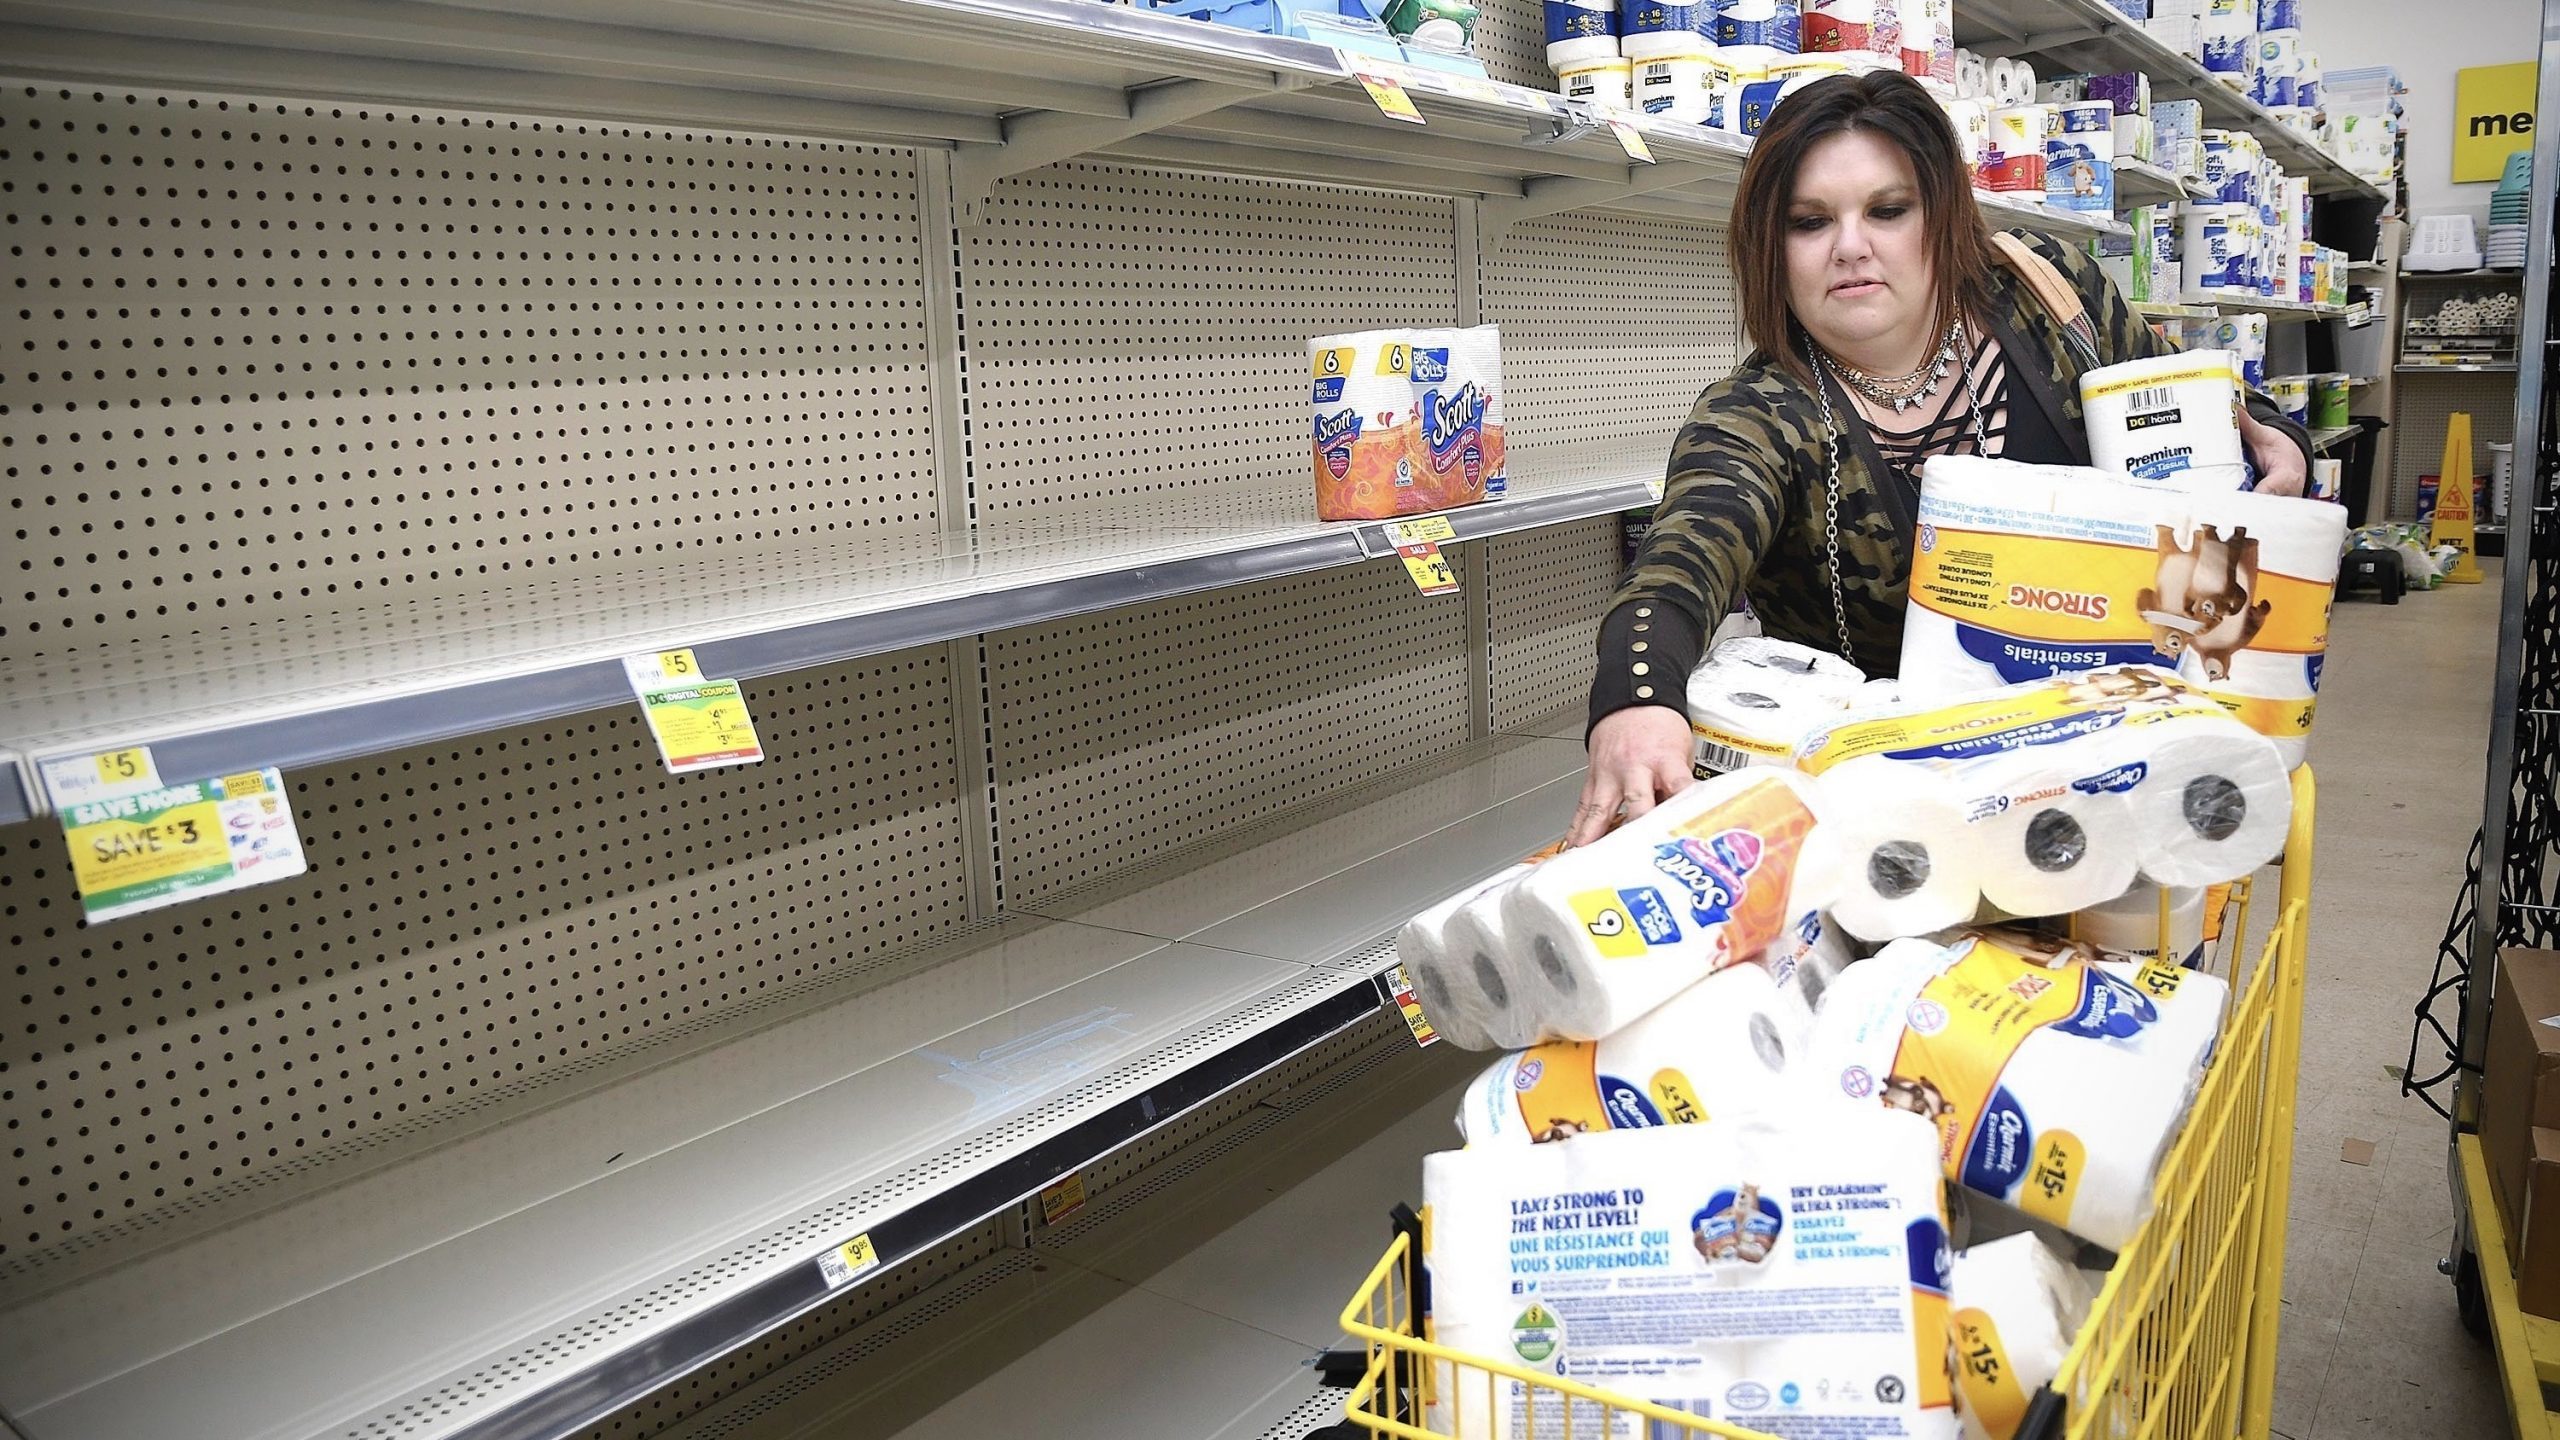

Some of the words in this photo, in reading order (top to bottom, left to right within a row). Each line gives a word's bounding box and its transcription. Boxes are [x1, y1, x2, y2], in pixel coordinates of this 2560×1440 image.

[2470, 112, 2533, 137] me
[1324, 350, 1339, 372] 6
[1391, 345, 1403, 371] 6
[1413, 351, 1430, 364] BIG
[1416, 365, 1444, 378] ROLLS
[2110, 383, 2127, 391] LOOK
[2132, 378, 2149, 387] SAME
[2172, 371, 2203, 380] PRODUCT
[1316, 382, 1327, 390] BIG
[1316, 389, 1339, 398] ROLLS
[1432, 381, 1474, 446] Scott
[2129, 417, 2146, 428] DG
[2150, 412, 2179, 424] home
[1319, 408, 1353, 442] Scott
[2126, 446, 2192, 471] Premium
[2158, 460, 2186, 472] Tissue
[2438, 509, 2469, 521] CAUTION
[2439, 538, 2463, 546] WET
[1940, 574, 1969, 584] LASTING
[1962, 567, 1992, 578] LONGUE
[1970, 578, 1991, 587] LONG
[1960, 591, 1978, 599] PLUS
[2011, 587, 2107, 619] STRONG
[2004, 643, 2107, 666] Essentials
[667, 690, 701, 702] DIGITAL
[701, 684, 736, 697] COUPON
[1713, 731, 1730, 742] SAME
[1731, 737, 1754, 748] GREAT
[1695, 766, 1711, 779] DG
[1998, 796, 2008, 812] 6
[2014, 786, 2066, 806] STRONG
[75, 798, 139, 824] SAVE
[95, 826, 162, 863] SAVE
[166, 819, 200, 844] $3
[1654, 853, 1730, 911] Scott
[1983, 1112, 2000, 1170] Essentials
[1995, 1109, 2023, 1173] Charmin
[2043, 1168, 2066, 1198] 15+
[1554, 1190, 1617, 1210] STRONG
[1623, 1189, 1644, 1205] TO
[1792, 1201, 1832, 1213] ULTRA
[1512, 1217, 1536, 1233] THE
[1543, 1213, 1580, 1230] NEXT
[1587, 1209, 1638, 1228] LEVEL!
[1510, 1237, 1539, 1253] UNE
[1545, 1230, 1633, 1251] RÉSISTANCE
[1641, 1230, 1669, 1246] QUI
[1511, 1257, 1549, 1273] VOUS
[1555, 1250, 1669, 1271] SURPRENDRA!
[1795, 1248, 1834, 1260] ULTRA
[1557, 1356, 1566, 1376] 6
[1972, 1343, 1998, 1384] 15+
